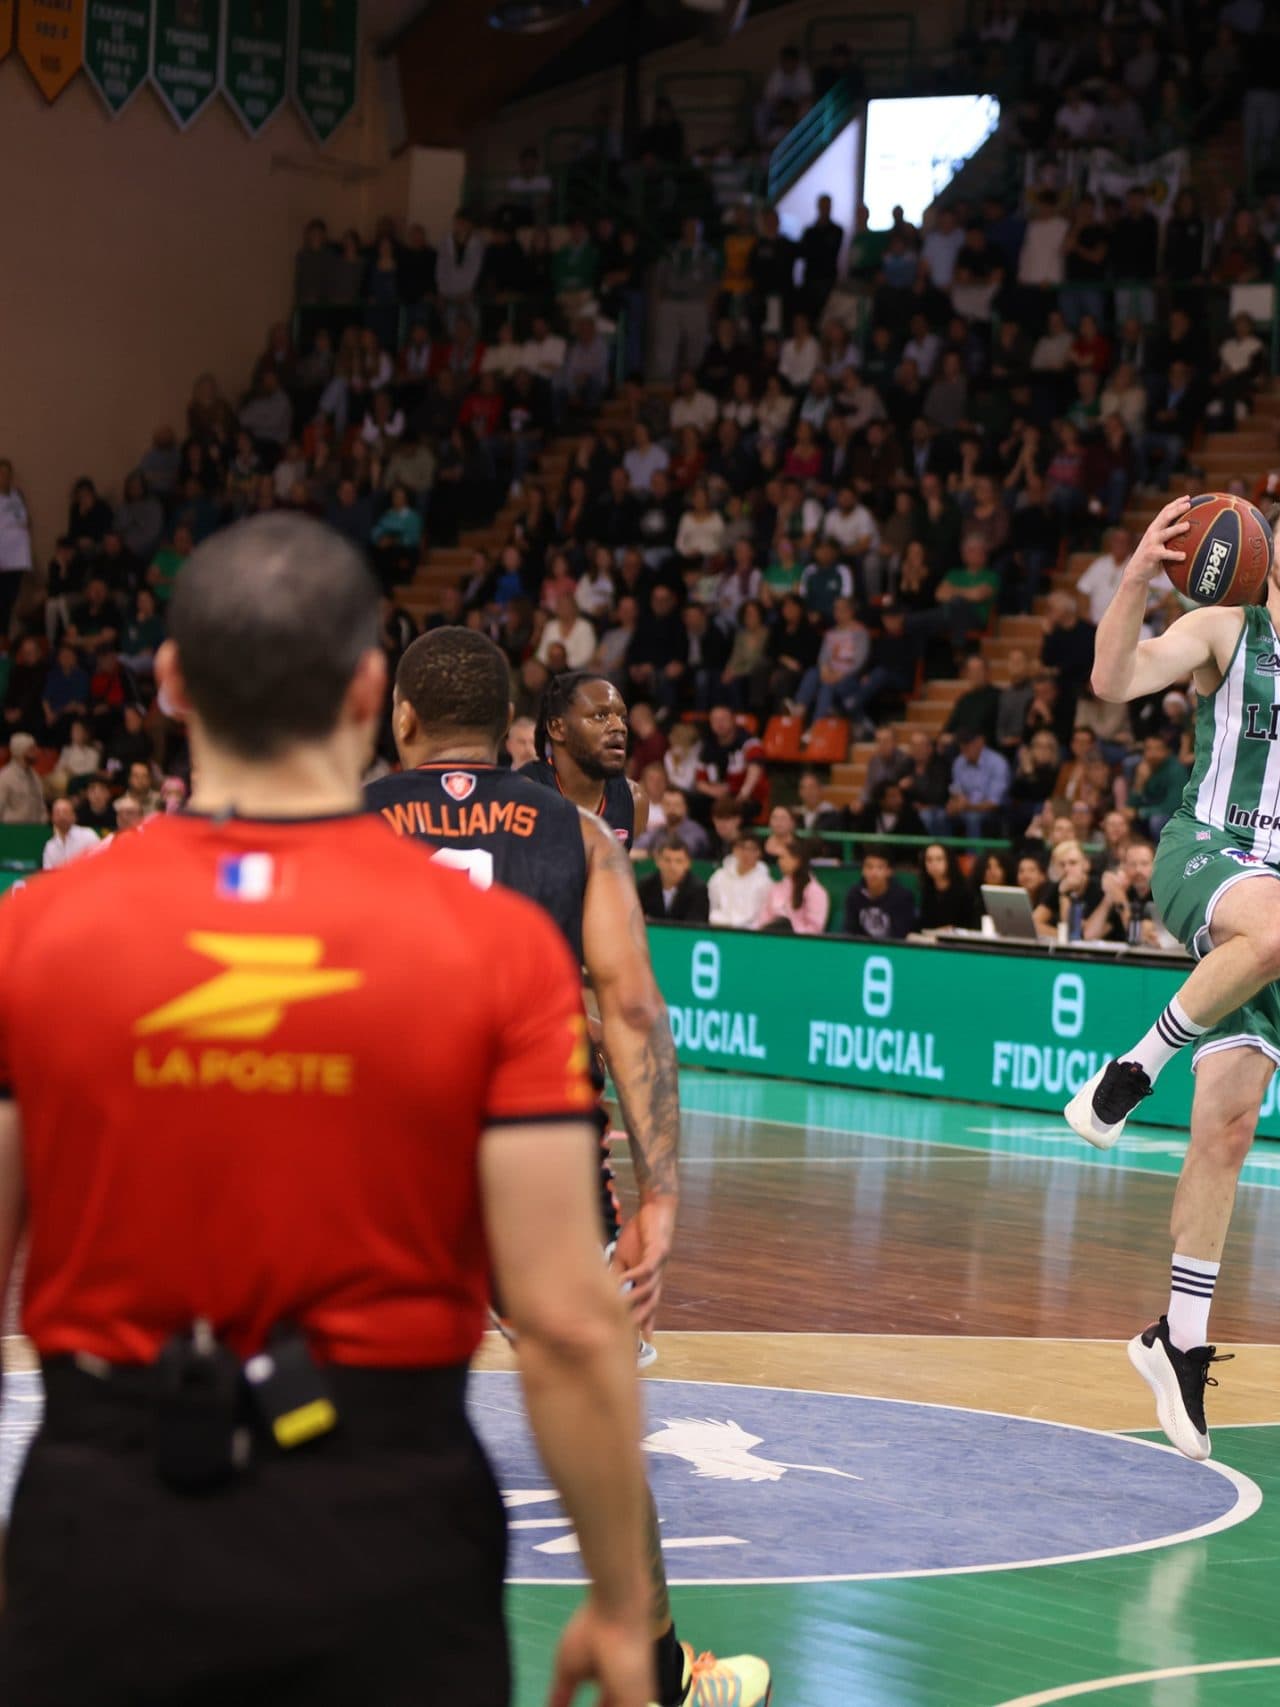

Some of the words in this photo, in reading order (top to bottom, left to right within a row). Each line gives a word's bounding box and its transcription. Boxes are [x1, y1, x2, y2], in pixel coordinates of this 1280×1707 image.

[1199, 542, 1228, 595] Betclic
[381, 801, 538, 837] WILLIAMS
[668, 1005, 766, 1060] DUCIAL
[808, 1020, 944, 1081] FIDUCIAL
[134, 1048, 199, 1088] LA
[201, 1049, 355, 1095] POSTE
[992, 1040, 1114, 1096] FIDUCI
